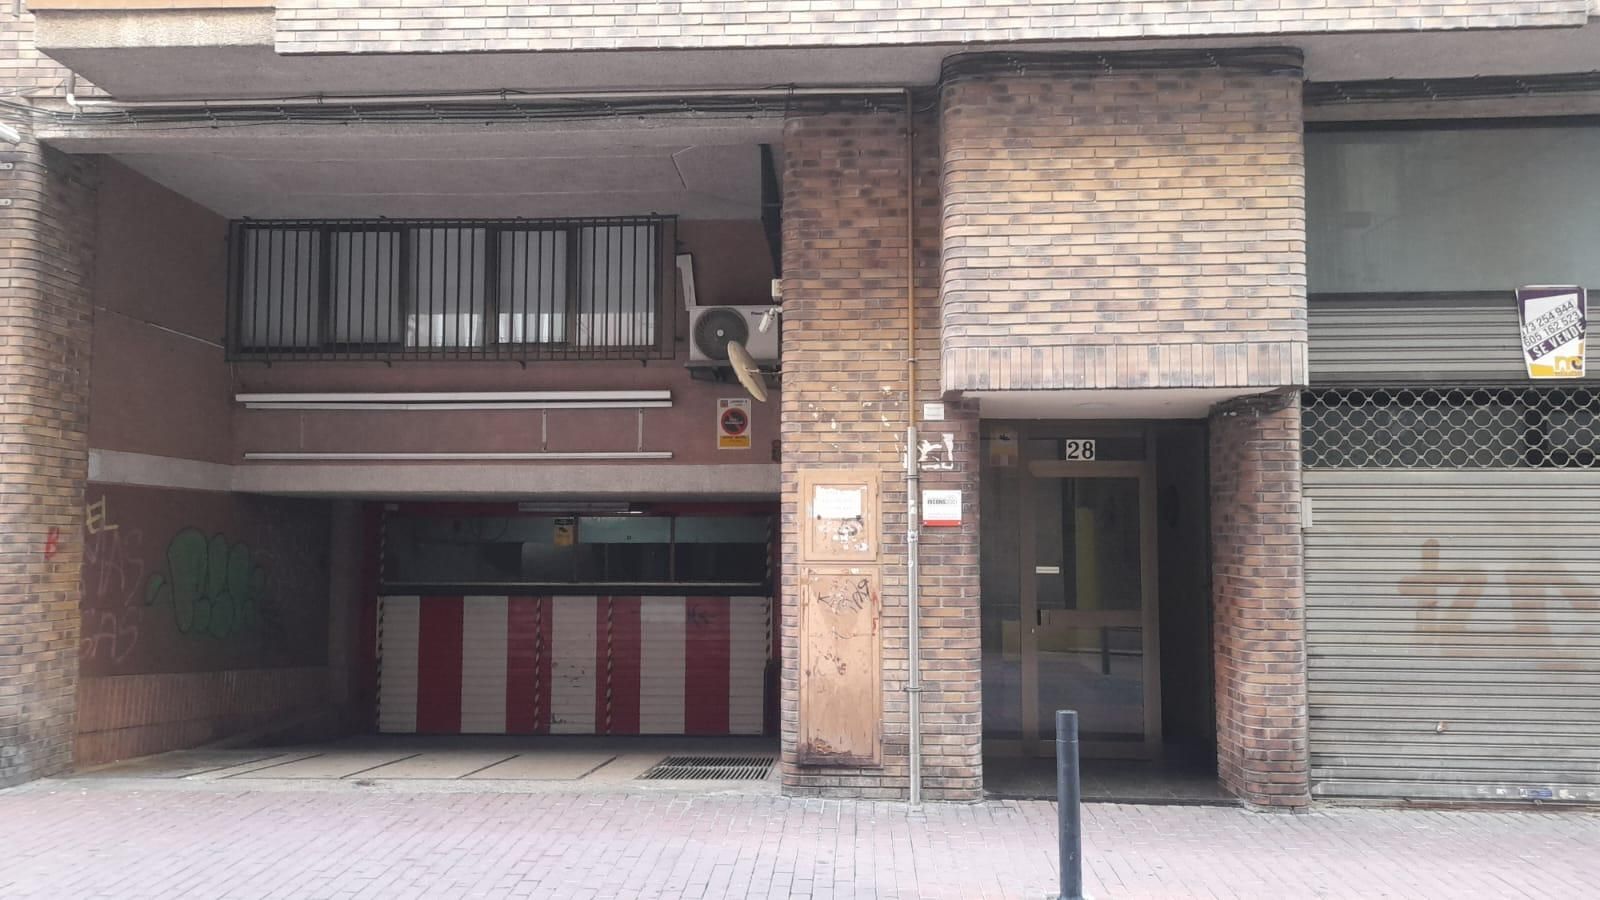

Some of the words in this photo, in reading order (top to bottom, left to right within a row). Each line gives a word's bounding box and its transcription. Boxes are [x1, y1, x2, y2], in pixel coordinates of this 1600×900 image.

[1523, 332, 1542, 348] 605
[1561, 311, 1580, 326] 523
[1536, 311, 1555, 328] 254
[1555, 300, 1574, 316] 944
[1532, 343, 1549, 358] SE
[1548, 322, 1585, 348] VENDE
[1068, 441, 1094, 459] 28
